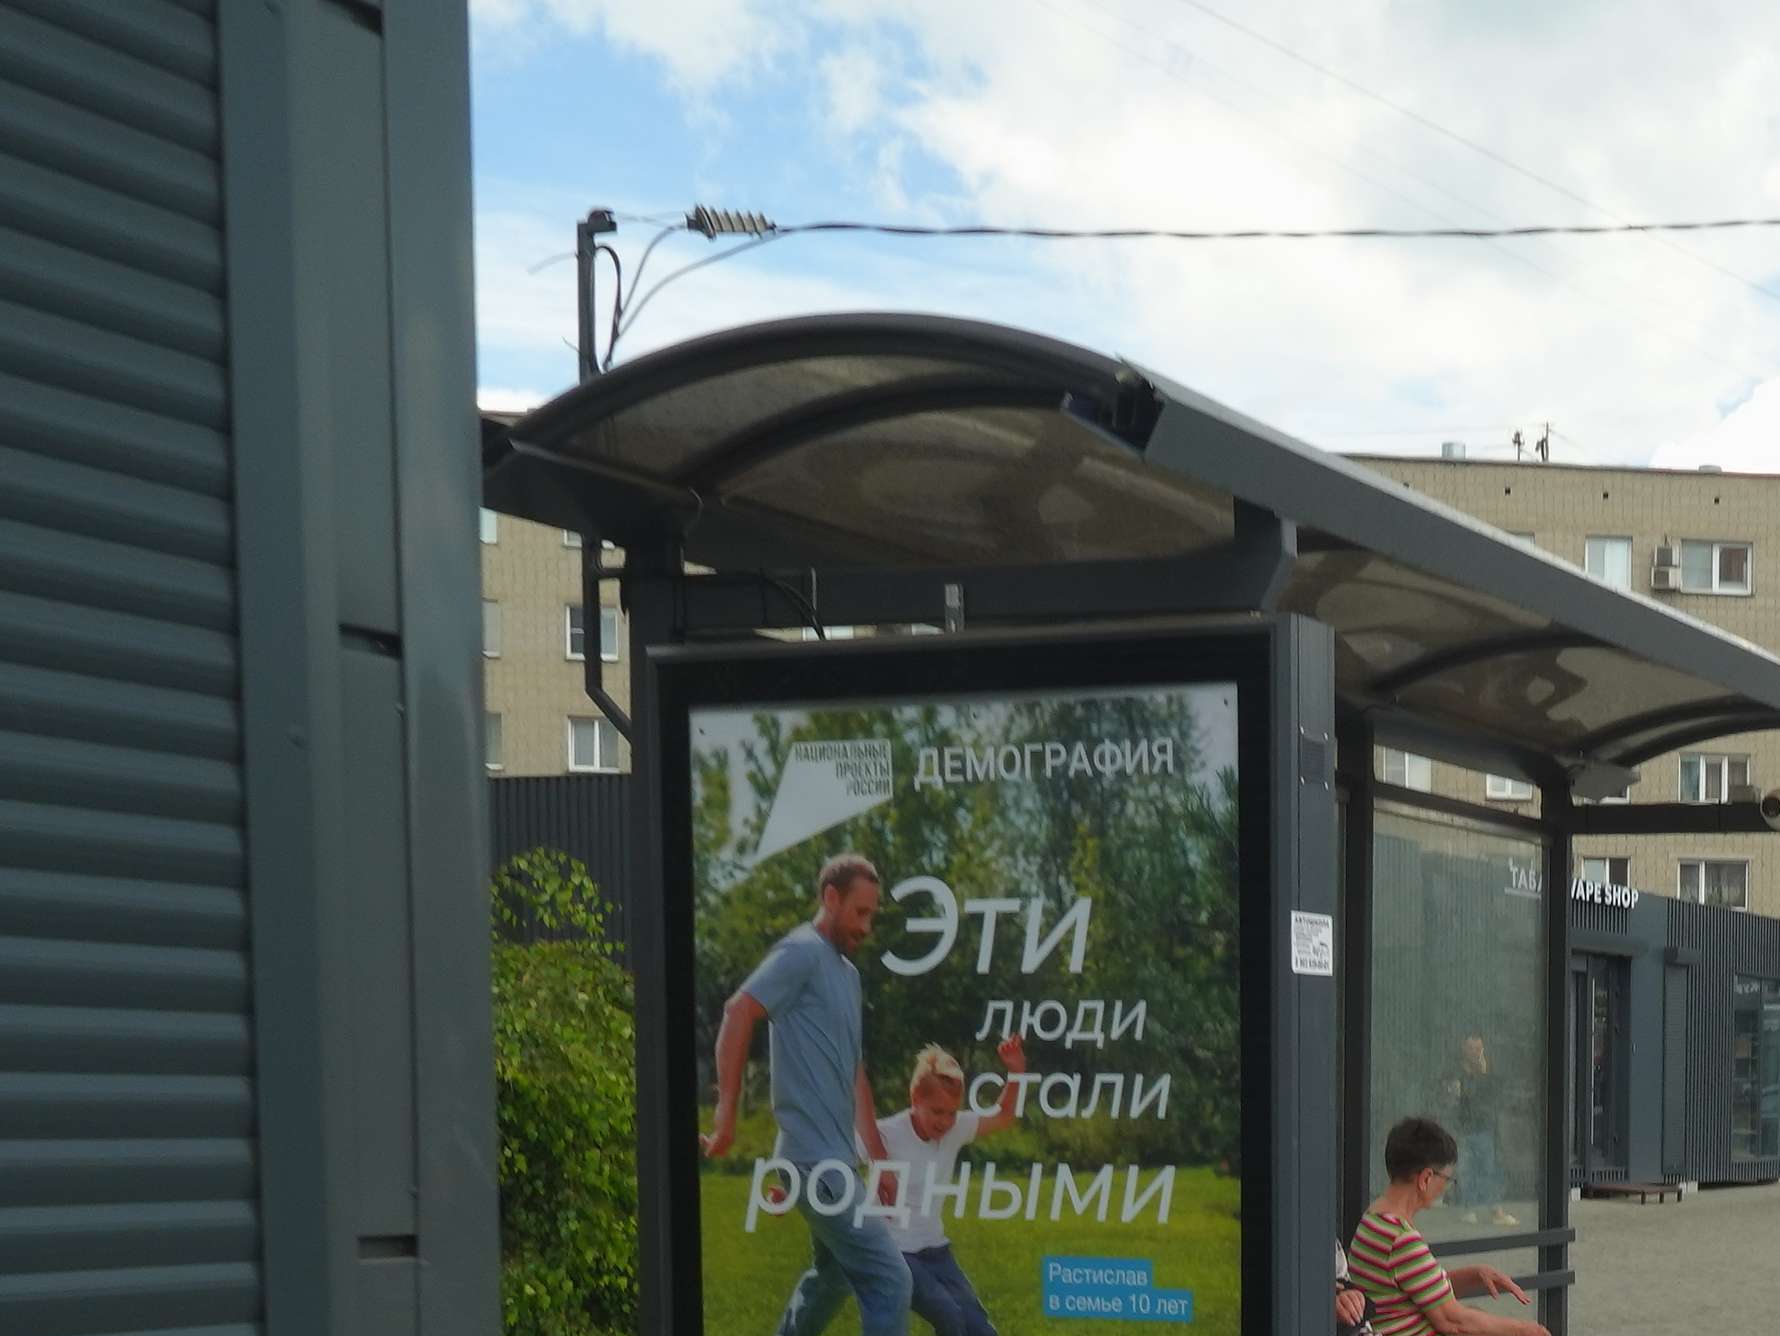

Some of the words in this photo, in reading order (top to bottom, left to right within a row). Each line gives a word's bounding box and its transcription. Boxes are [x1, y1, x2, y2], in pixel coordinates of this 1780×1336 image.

[794, 742, 889, 763] НАЦИОНАЛЬНЫЕ
[913, 737, 1174, 792] ДЕМОГРАФИЯ
[835, 760, 891, 779] ПРОЕКТЫ
[845, 778, 891, 797] РОССИИ
[1605, 882, 1639, 909] SHOP
[880, 875, 1093, 977] Эти
[976, 999, 1147, 1049] люди
[969, 1072, 1172, 1120] стали
[744, 1157, 1176, 1232] родными
[1049, 1262, 1148, 1286] Растислав
[1049, 1294, 1060, 1311] в
[1065, 1295, 1123, 1313] семье
[1130, 1293, 1150, 1313] 10
[1156, 1298, 1188, 1315] лет
